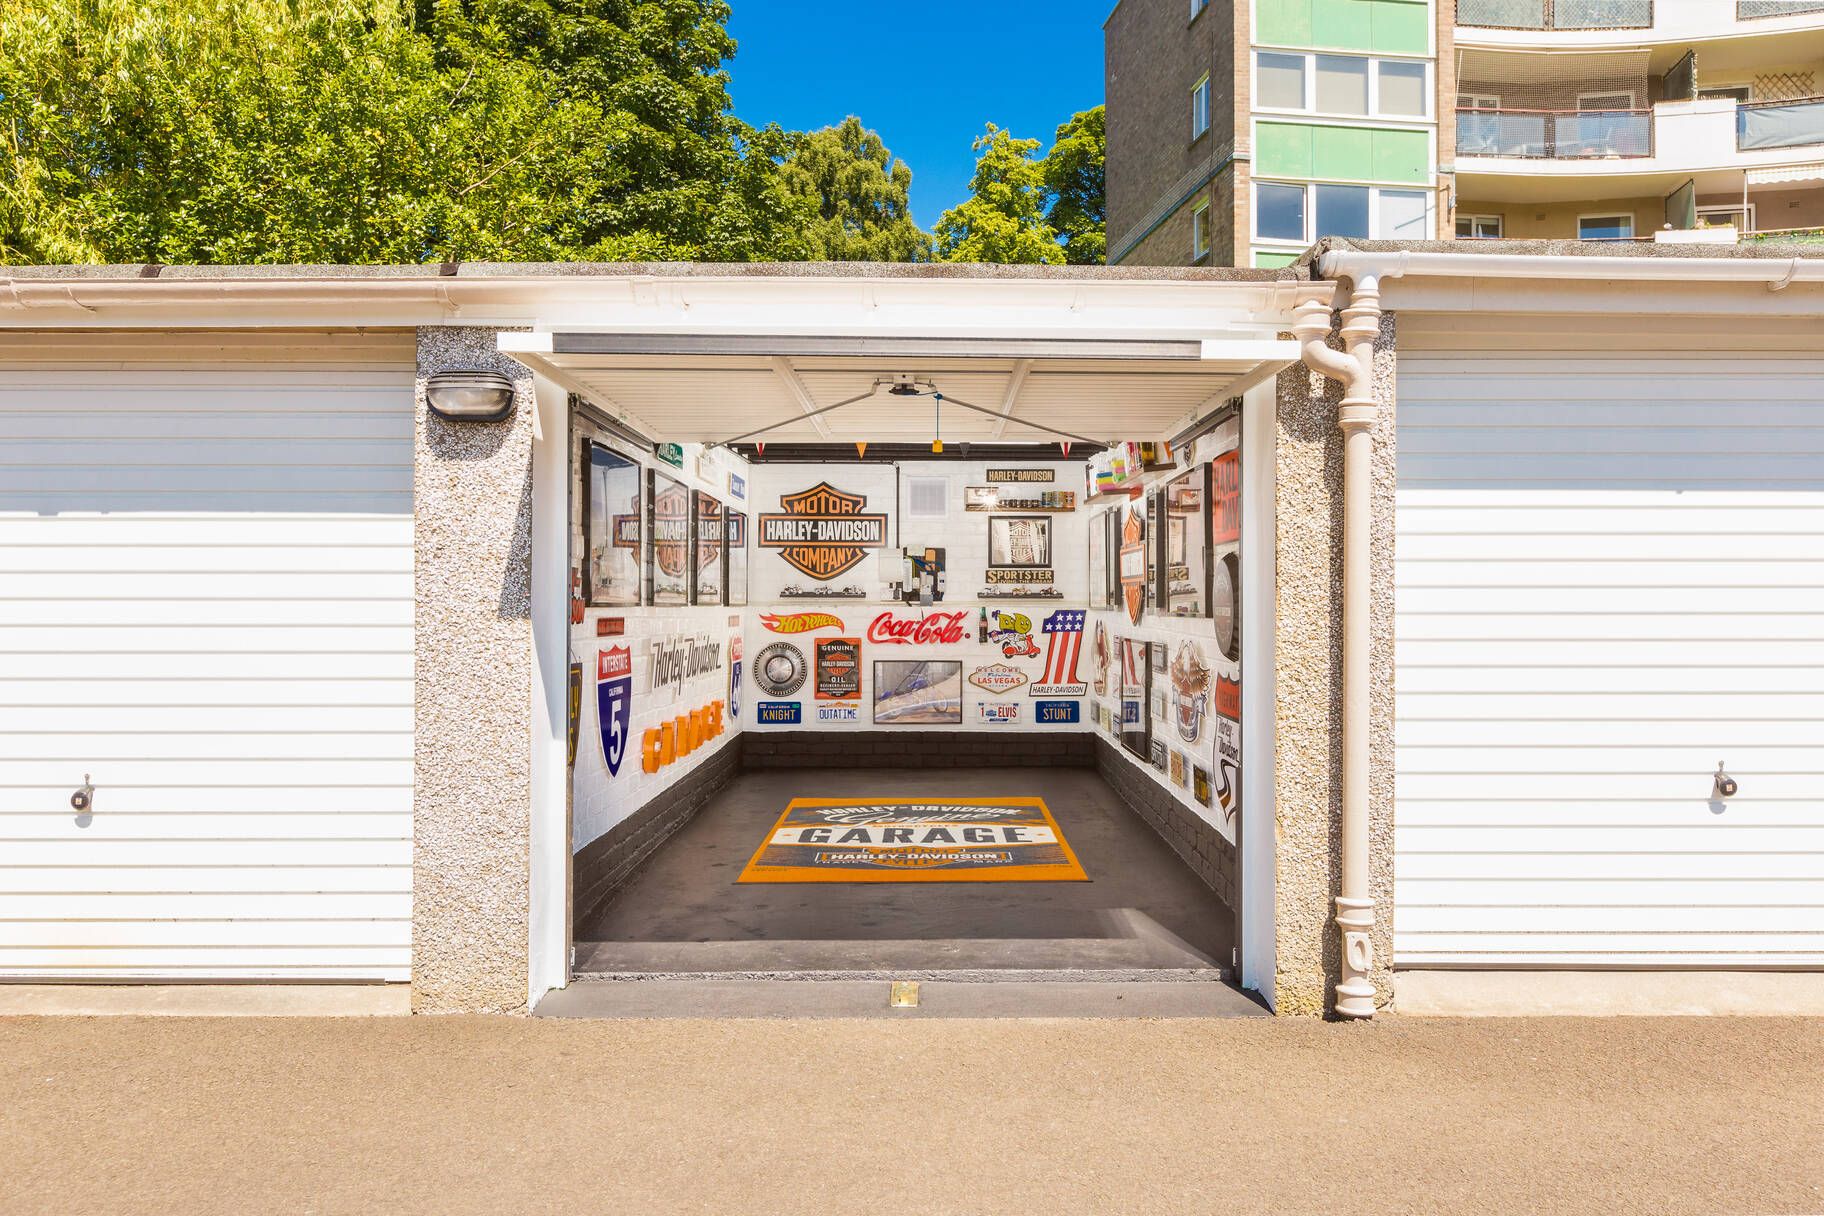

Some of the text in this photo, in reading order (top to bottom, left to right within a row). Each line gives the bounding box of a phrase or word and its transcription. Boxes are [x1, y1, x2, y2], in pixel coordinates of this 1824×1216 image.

[988, 470, 1053, 481] HARLEY-DAVIDSON
[793, 491, 853, 514] MOTOR
[766, 520, 880, 541] HARLEY-DAVIDSON
[792, 547, 854, 574] COMPANY
[988, 570, 1052, 583] SPORTSTER
[867, 608, 969, 645] Coca-Cola
[602, 654, 628, 674] INTERSTATE
[653, 634, 721, 696] Harley-Davidson
[1032, 686, 1084, 694] HARLEY-DAVIDSON
[763, 709, 796, 720] KNIGHT
[819, 708, 857, 720] OUTATIME
[997, 706, 1017, 718] ELVIS
[1043, 708, 1072, 720] STUNT
[609, 699, 623, 765] 5
[798, 827, 1033, 844] GARAGE
